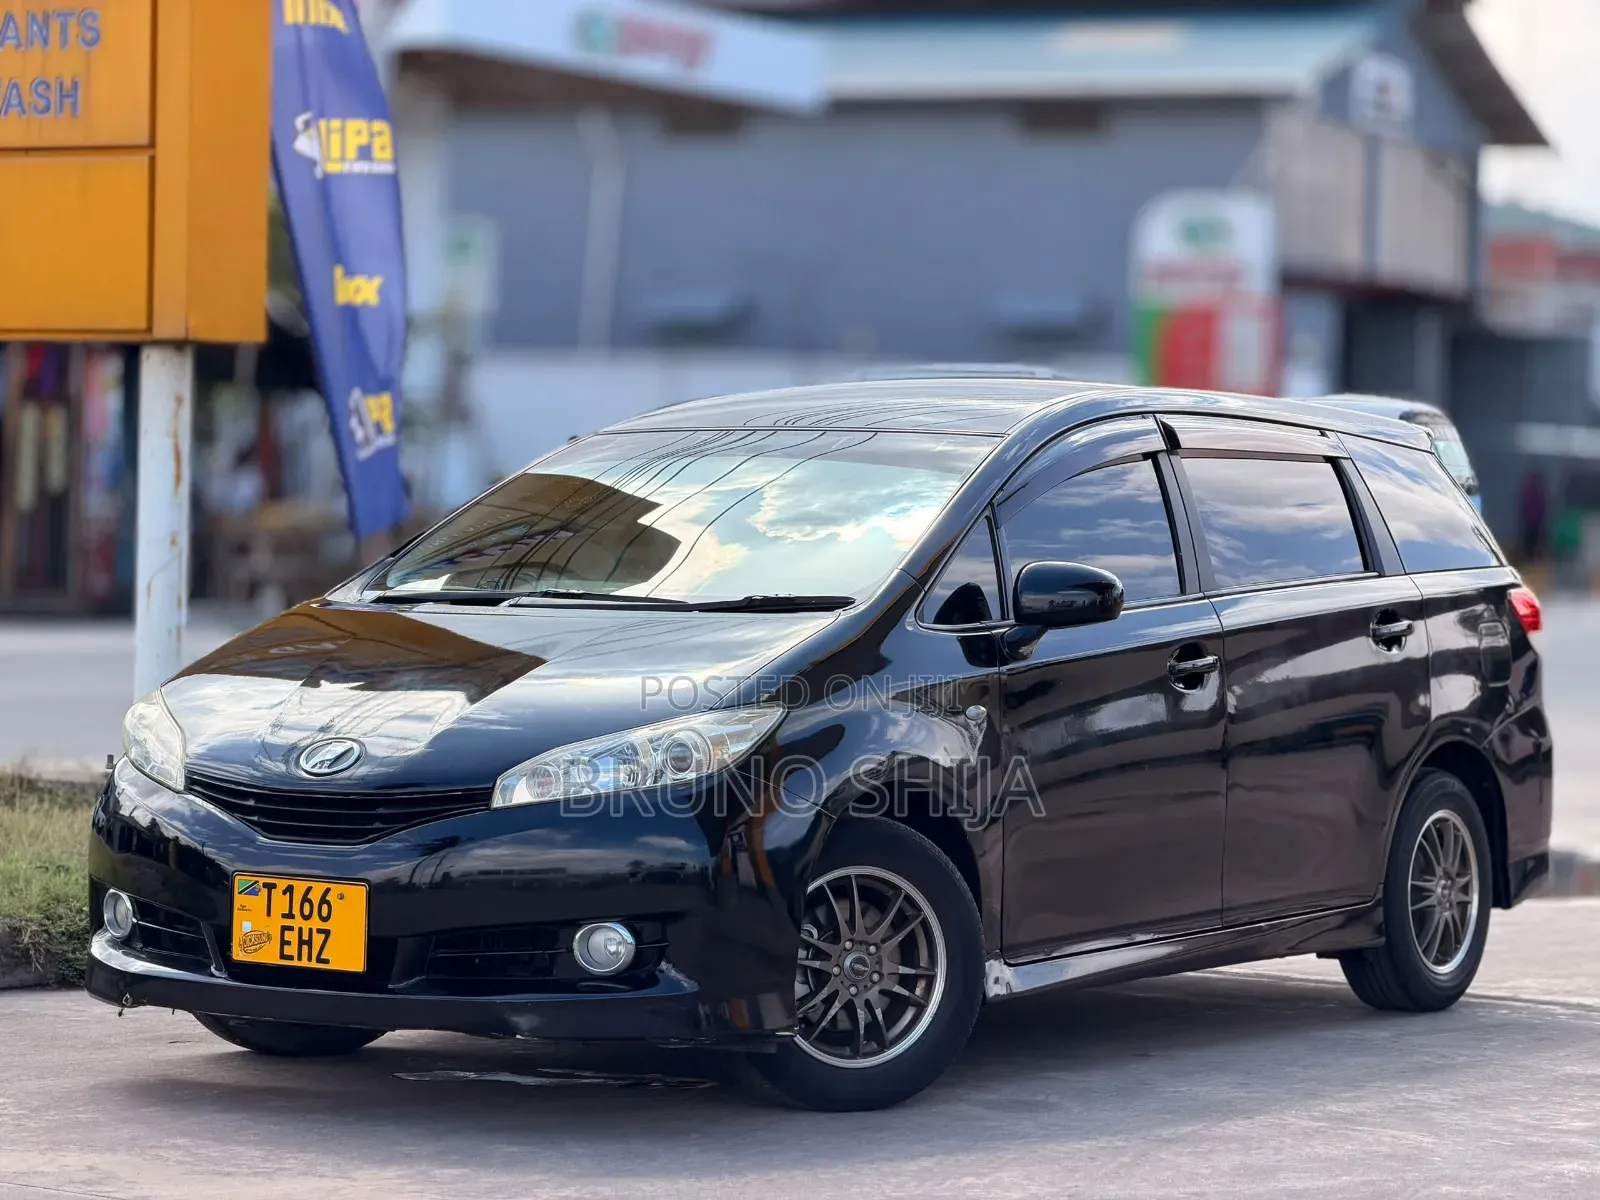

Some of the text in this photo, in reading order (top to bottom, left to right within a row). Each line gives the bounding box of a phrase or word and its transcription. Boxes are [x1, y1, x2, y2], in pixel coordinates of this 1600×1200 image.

[0, 77, 80, 118] ASH
[262, 882, 332, 922] T166
[279, 925, 331, 964] EHZ
